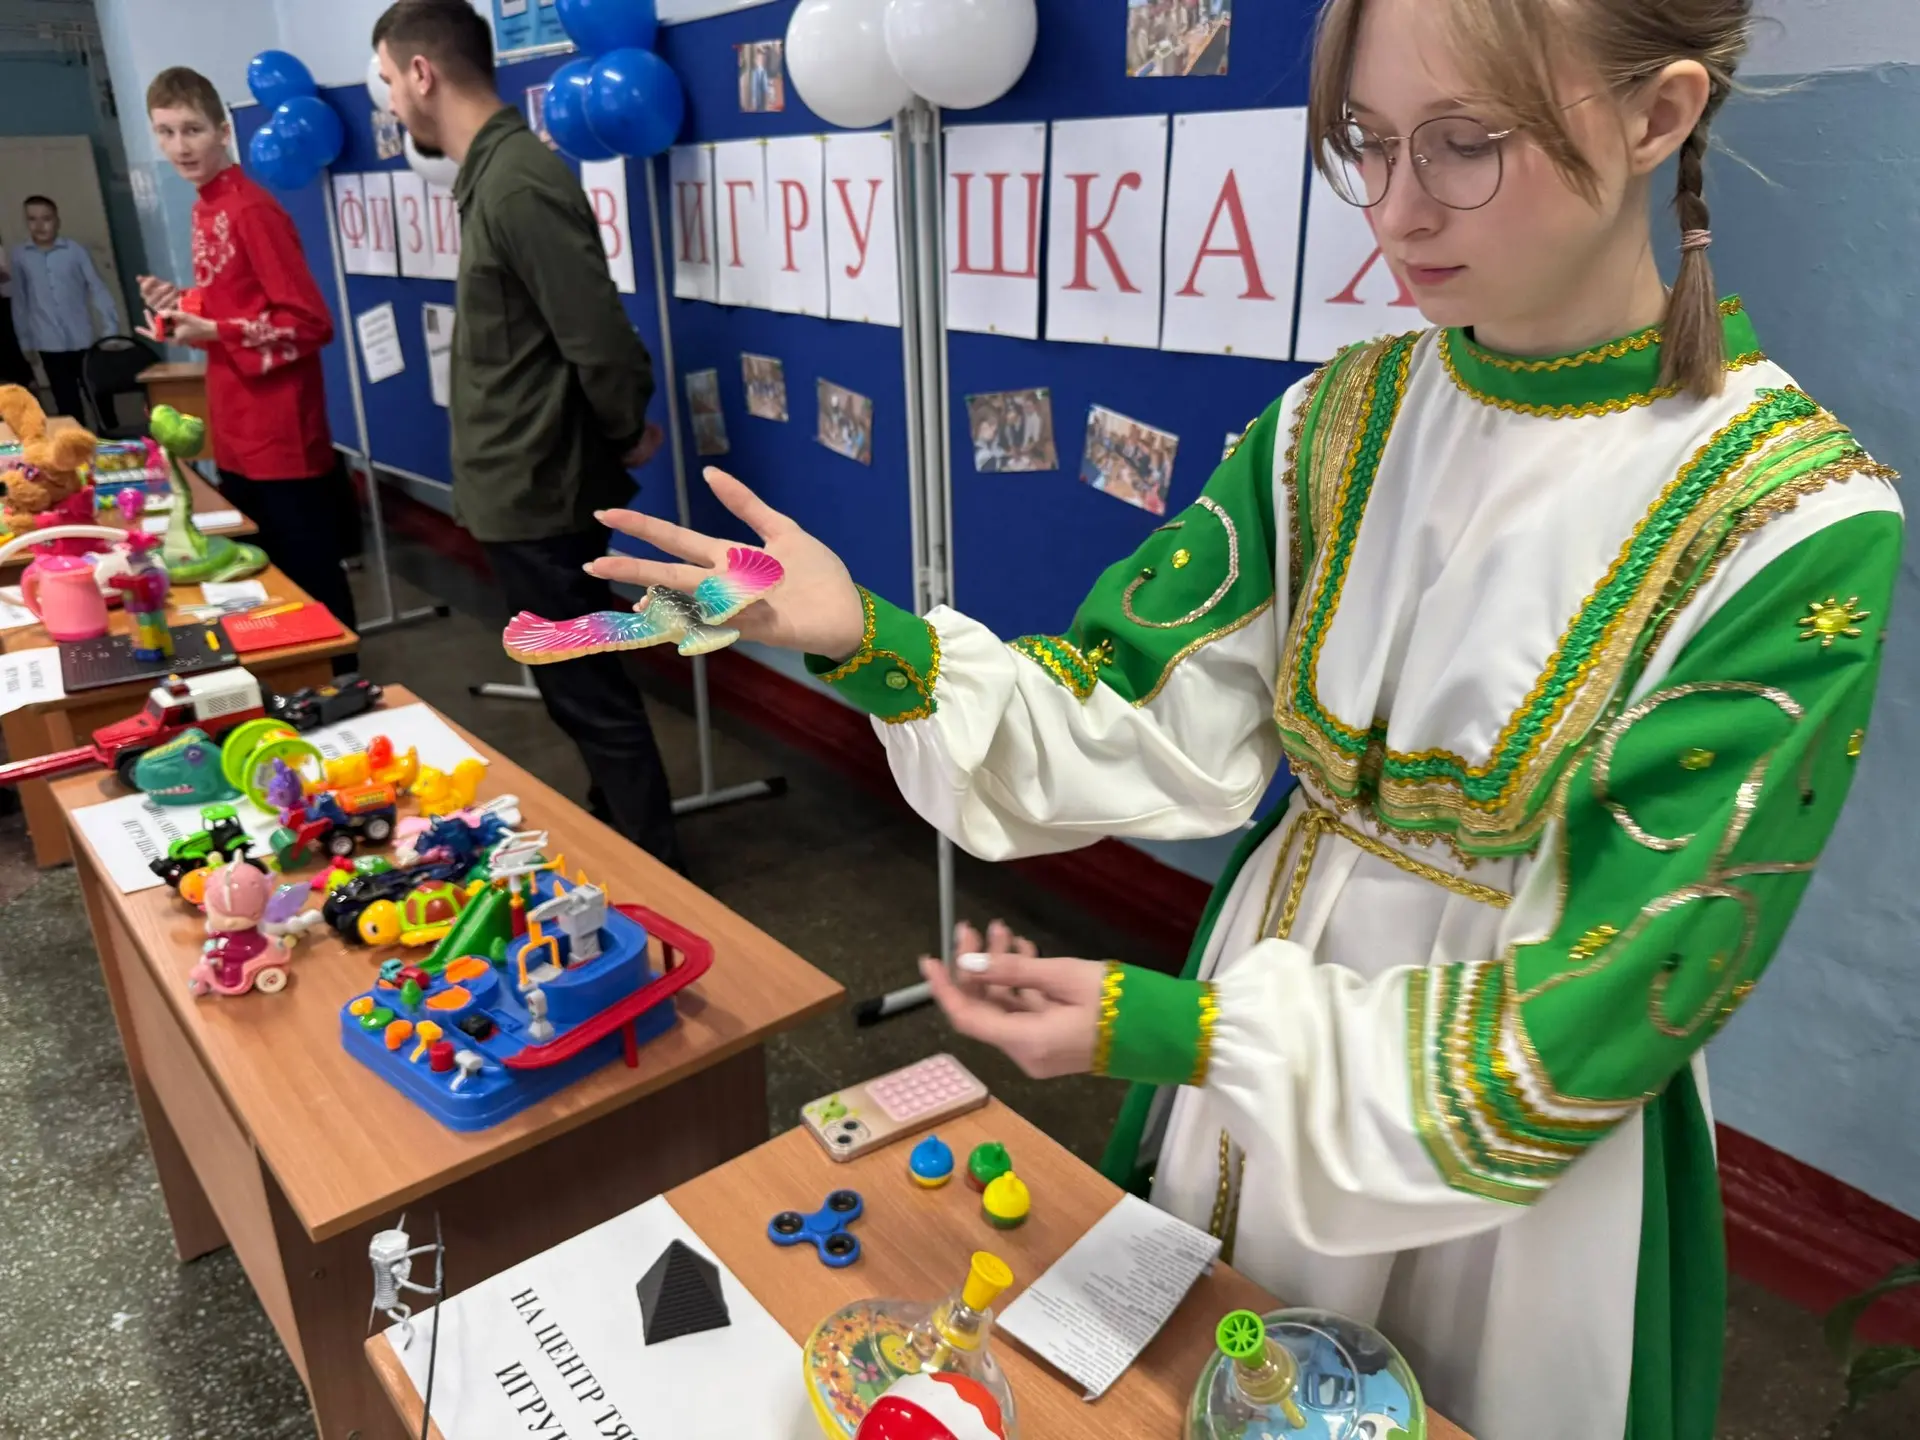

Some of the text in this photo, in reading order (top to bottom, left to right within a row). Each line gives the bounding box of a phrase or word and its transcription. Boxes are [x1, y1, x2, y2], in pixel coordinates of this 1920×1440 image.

[339, 188, 460, 255] ФИЗИ
[590, 187, 622, 260] В
[510, 1287, 640, 1440] НА ЦЕНТР ТЯ
